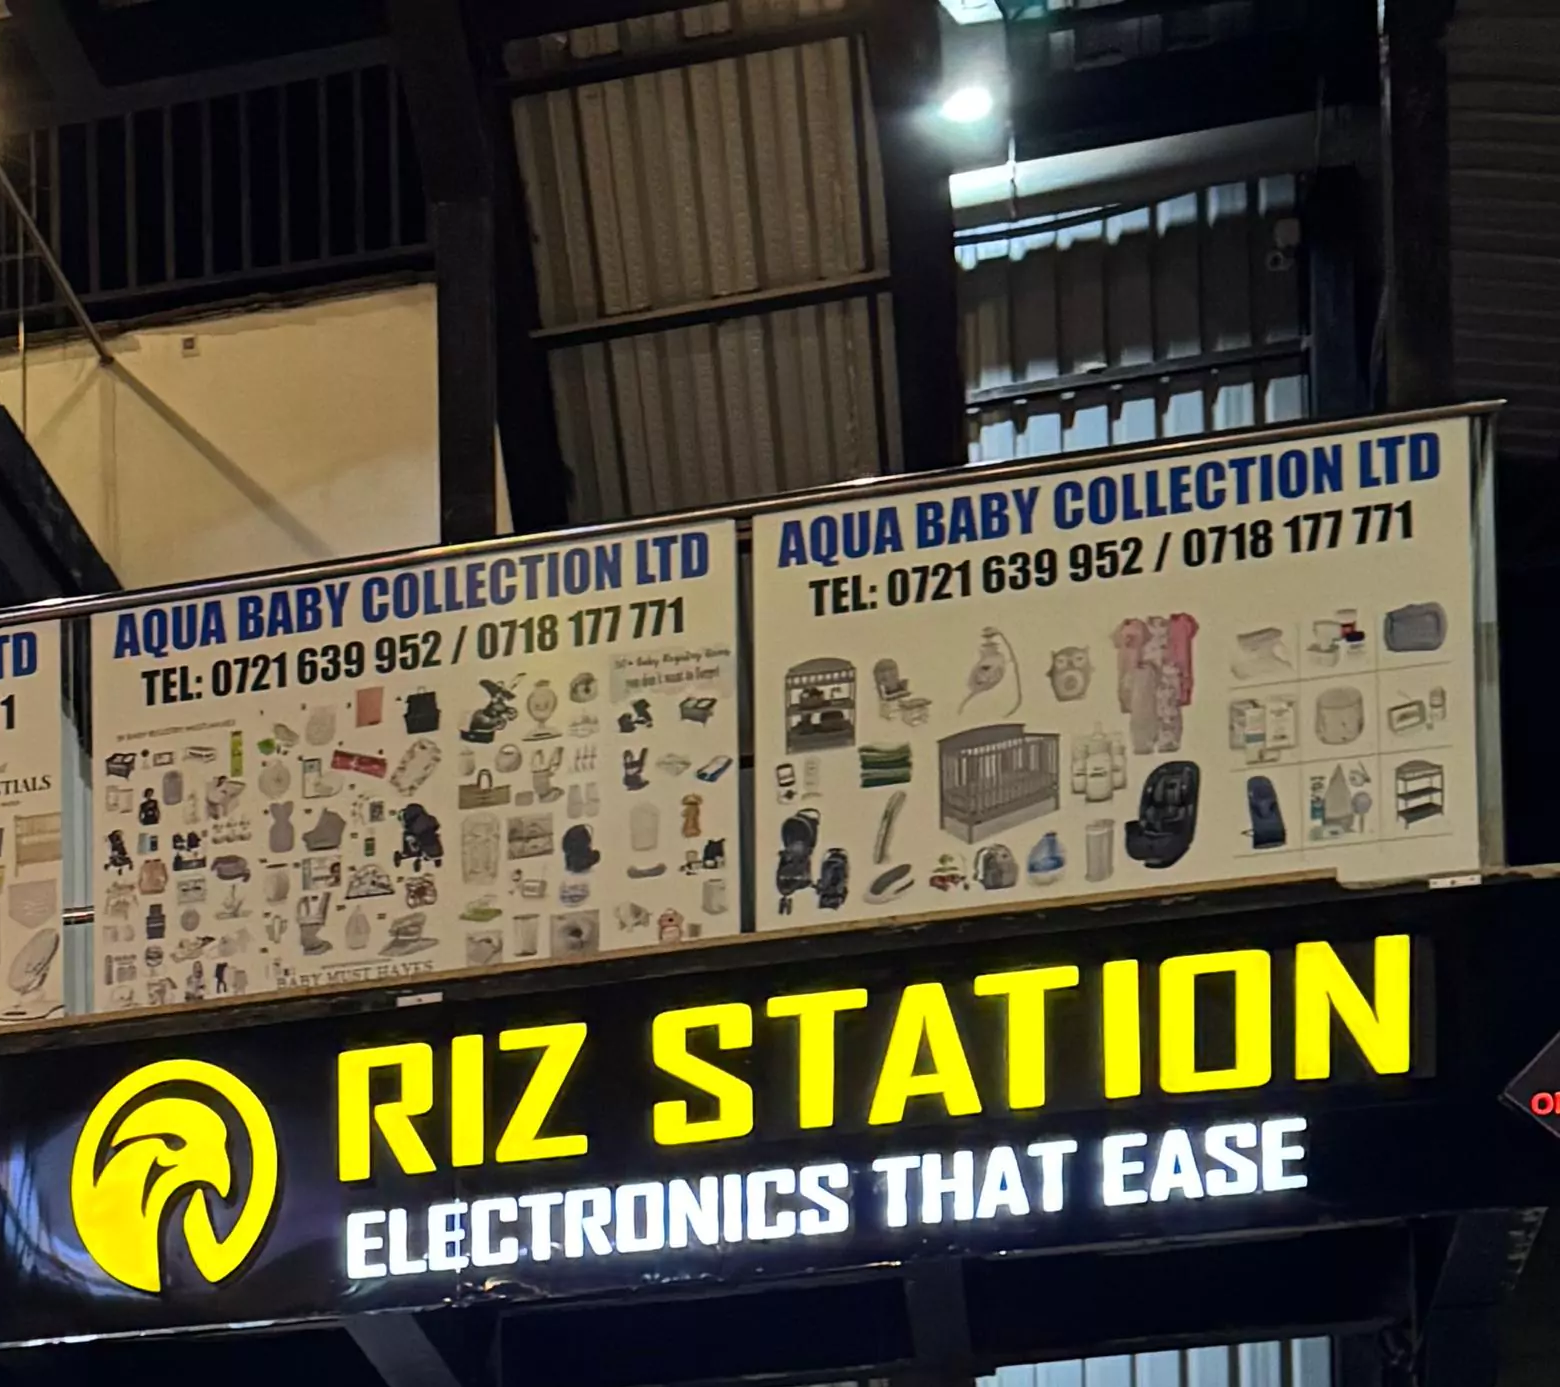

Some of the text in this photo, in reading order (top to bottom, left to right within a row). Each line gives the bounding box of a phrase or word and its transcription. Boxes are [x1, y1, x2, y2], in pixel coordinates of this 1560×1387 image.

[777, 431, 1441, 570] AQUA BABY COLLECTION LTD
[809, 500, 1414, 617] TEL: 0721 639 952 / 0718 177 771
[113, 531, 710, 660] AQUA BABY COLLECTION LTD
[141, 596, 685, 707] TEL: 0721 639 952 / 0718 177 771
[276, 960, 434, 988] BABY MUST HAVES
[336, 933, 1413, 1185] RIZ STATION
[345, 1117, 1310, 1283] ELECTRONICS THAT EASE
